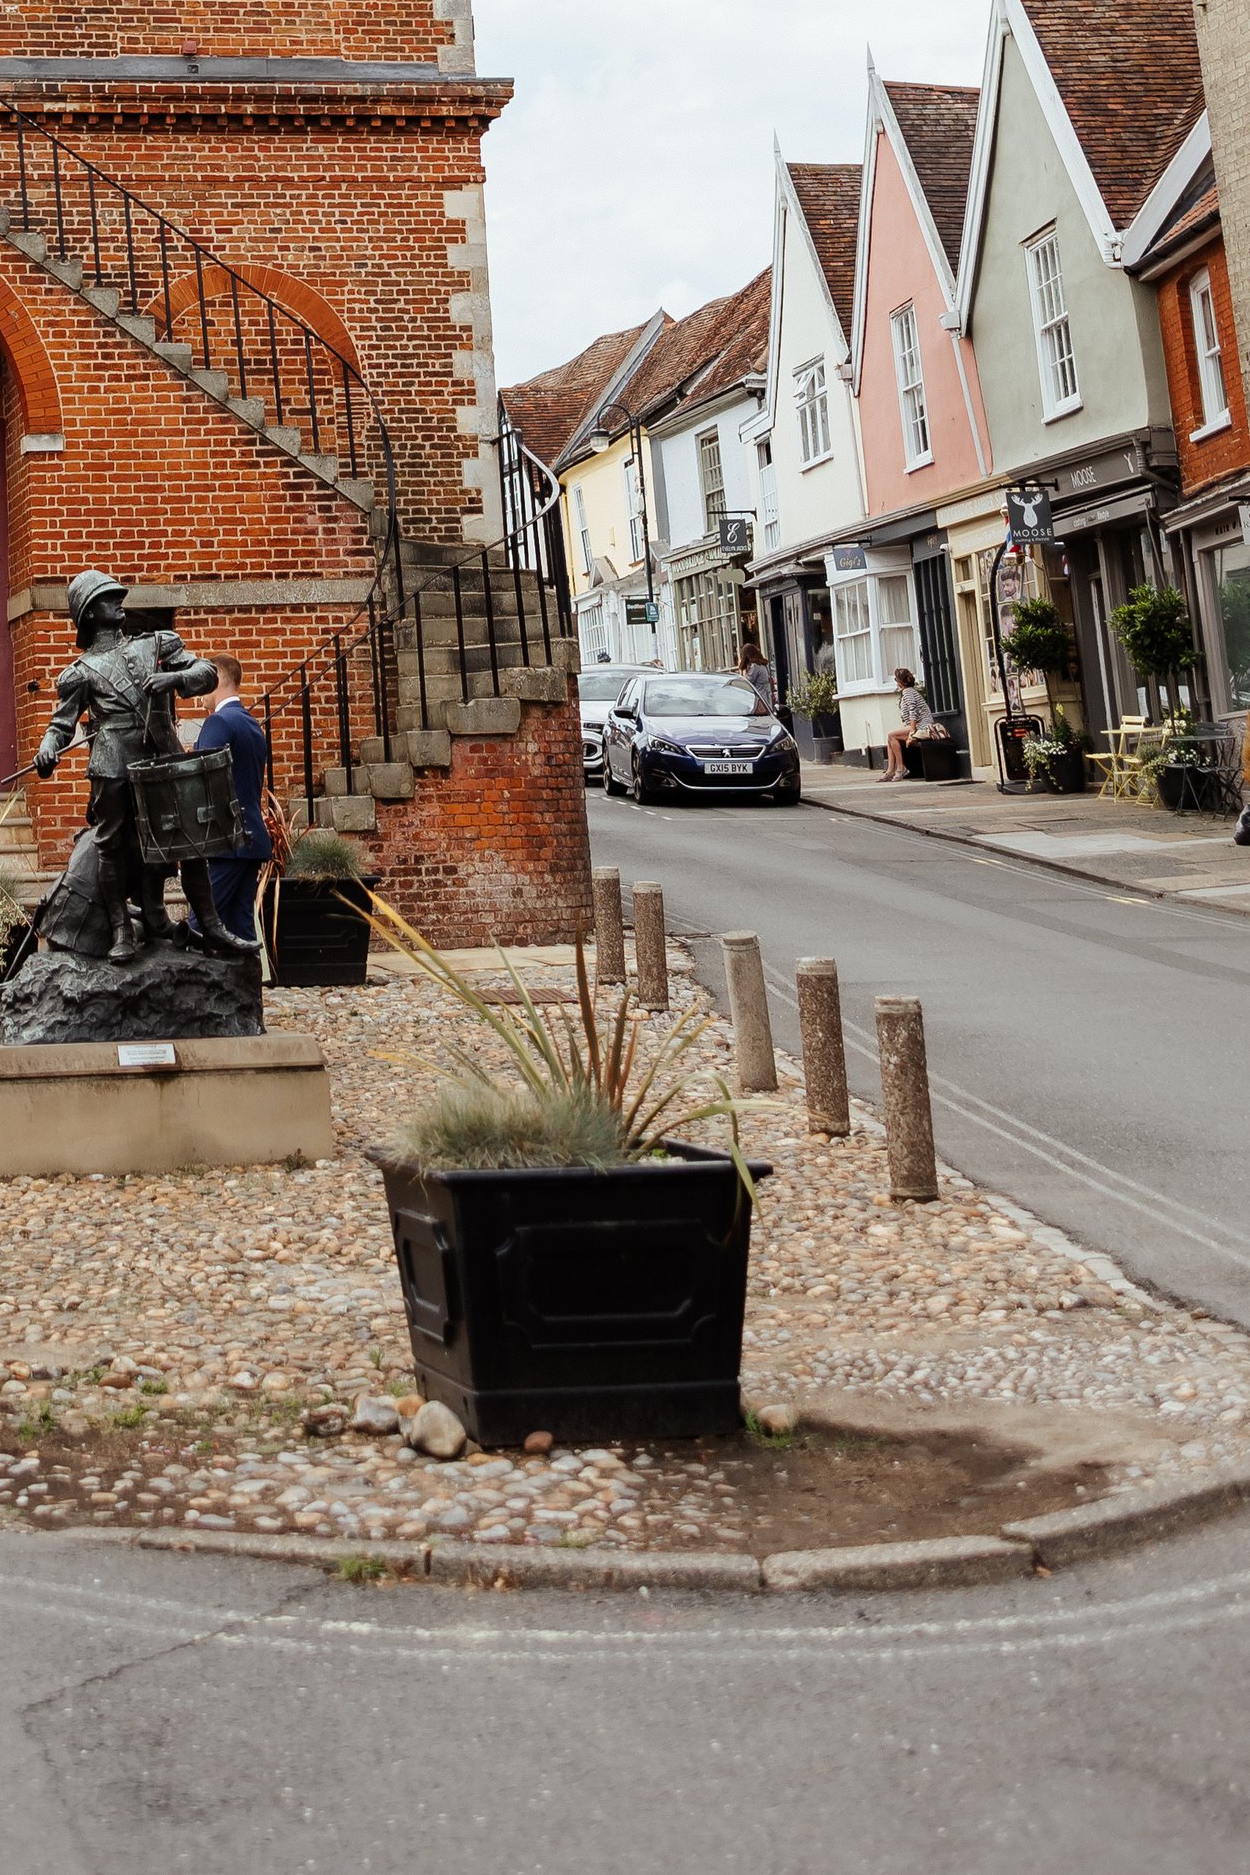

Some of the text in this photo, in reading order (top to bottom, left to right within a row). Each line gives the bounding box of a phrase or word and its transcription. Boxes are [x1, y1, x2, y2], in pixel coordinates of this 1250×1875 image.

[1070, 466, 1097, 488] MOOSE
[1013, 527, 1053, 537] MOOSE
[710, 763, 748, 773] GX15 BYK
